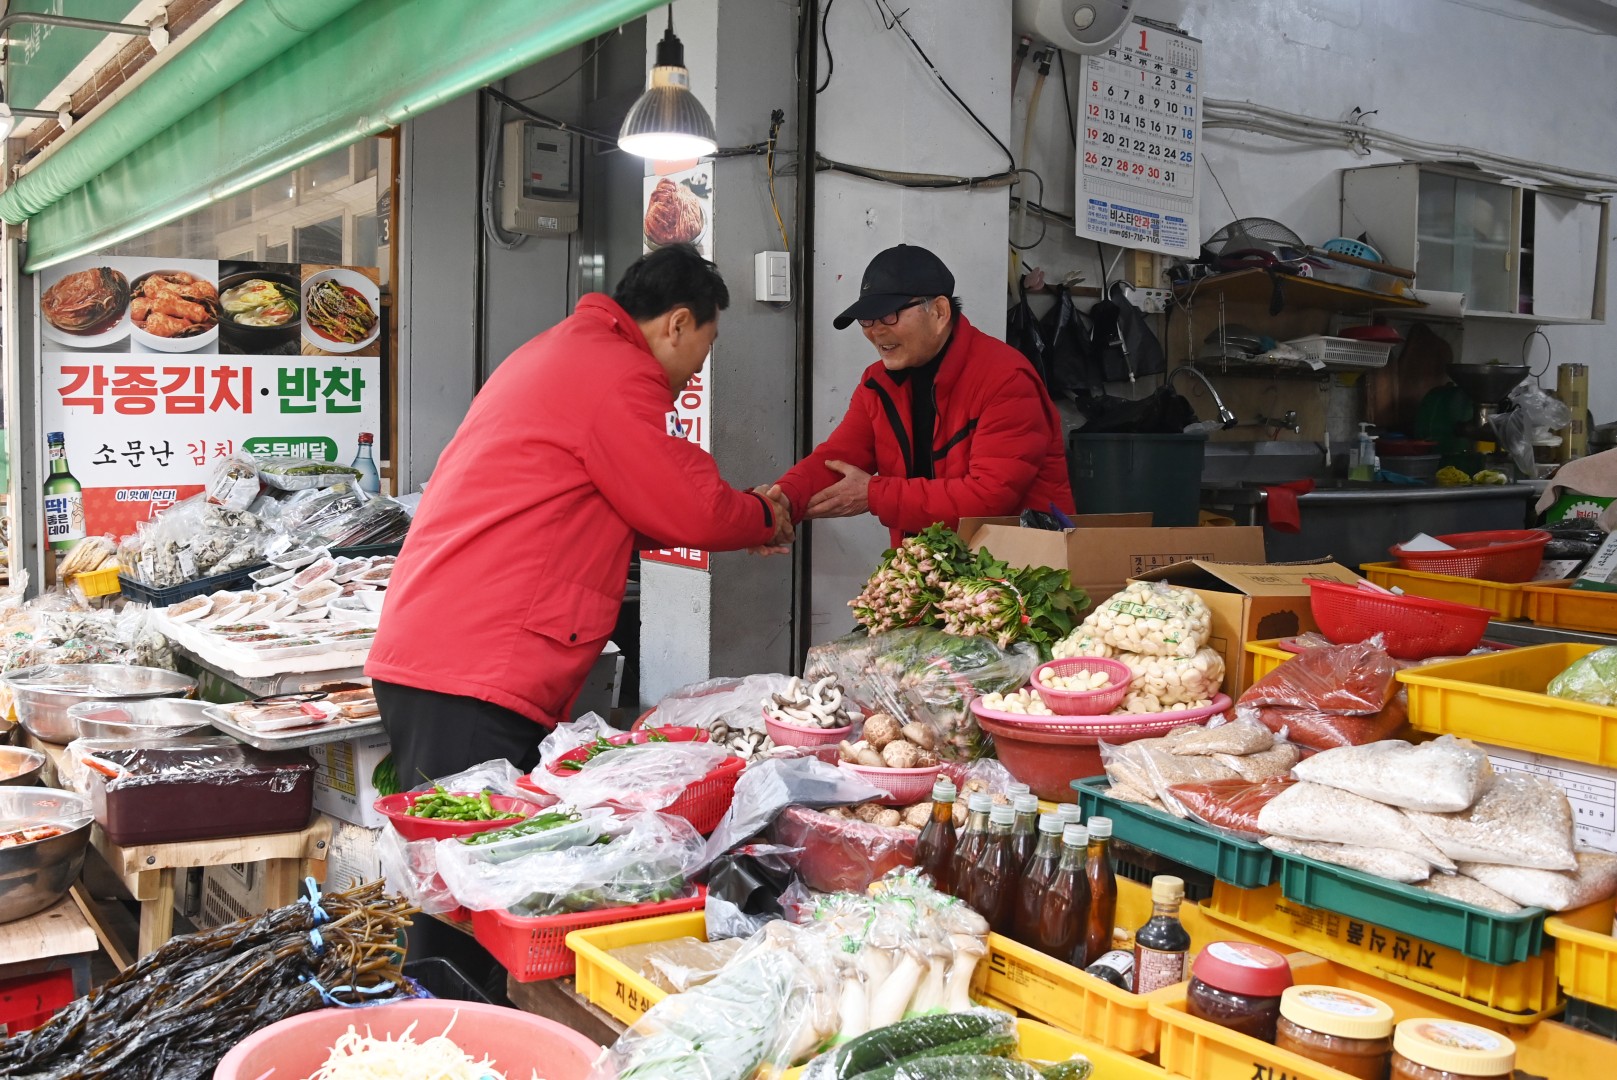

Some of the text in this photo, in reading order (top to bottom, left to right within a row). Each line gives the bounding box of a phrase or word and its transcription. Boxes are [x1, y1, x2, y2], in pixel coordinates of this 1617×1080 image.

[1139, 30, 1148, 51] 1
[1141, 72, 1192, 93] 1 2 3 4
[1185, 71, 1193, 79] 土
[1092, 81, 1193, 117] 5 6 7 8 9 10 11
[1088, 104, 1193, 140] 12 13 14 15 16 17 18
[1087, 128, 1193, 163] 19 20 21 22 23 24 25
[1085, 151, 1175, 182] 26 27 28 29 30 31
[1110, 209, 1150, 229] 비스타안과
[92, 440, 175, 467] 소문난
[186, 439, 233, 466] 김치
[253, 442, 328, 462] 주문배달
[45, 498, 67, 513] 딱!
[116, 490, 127, 500] 이
[152, 490, 176, 500] 산다!
[47, 513, 68, 526] 좋은
[48, 524, 69, 536] 데이
[1151, 556, 1157, 565] 8
[1169, 556, 1175, 564] 9
[1346, 920, 1436, 969] 지산식품
